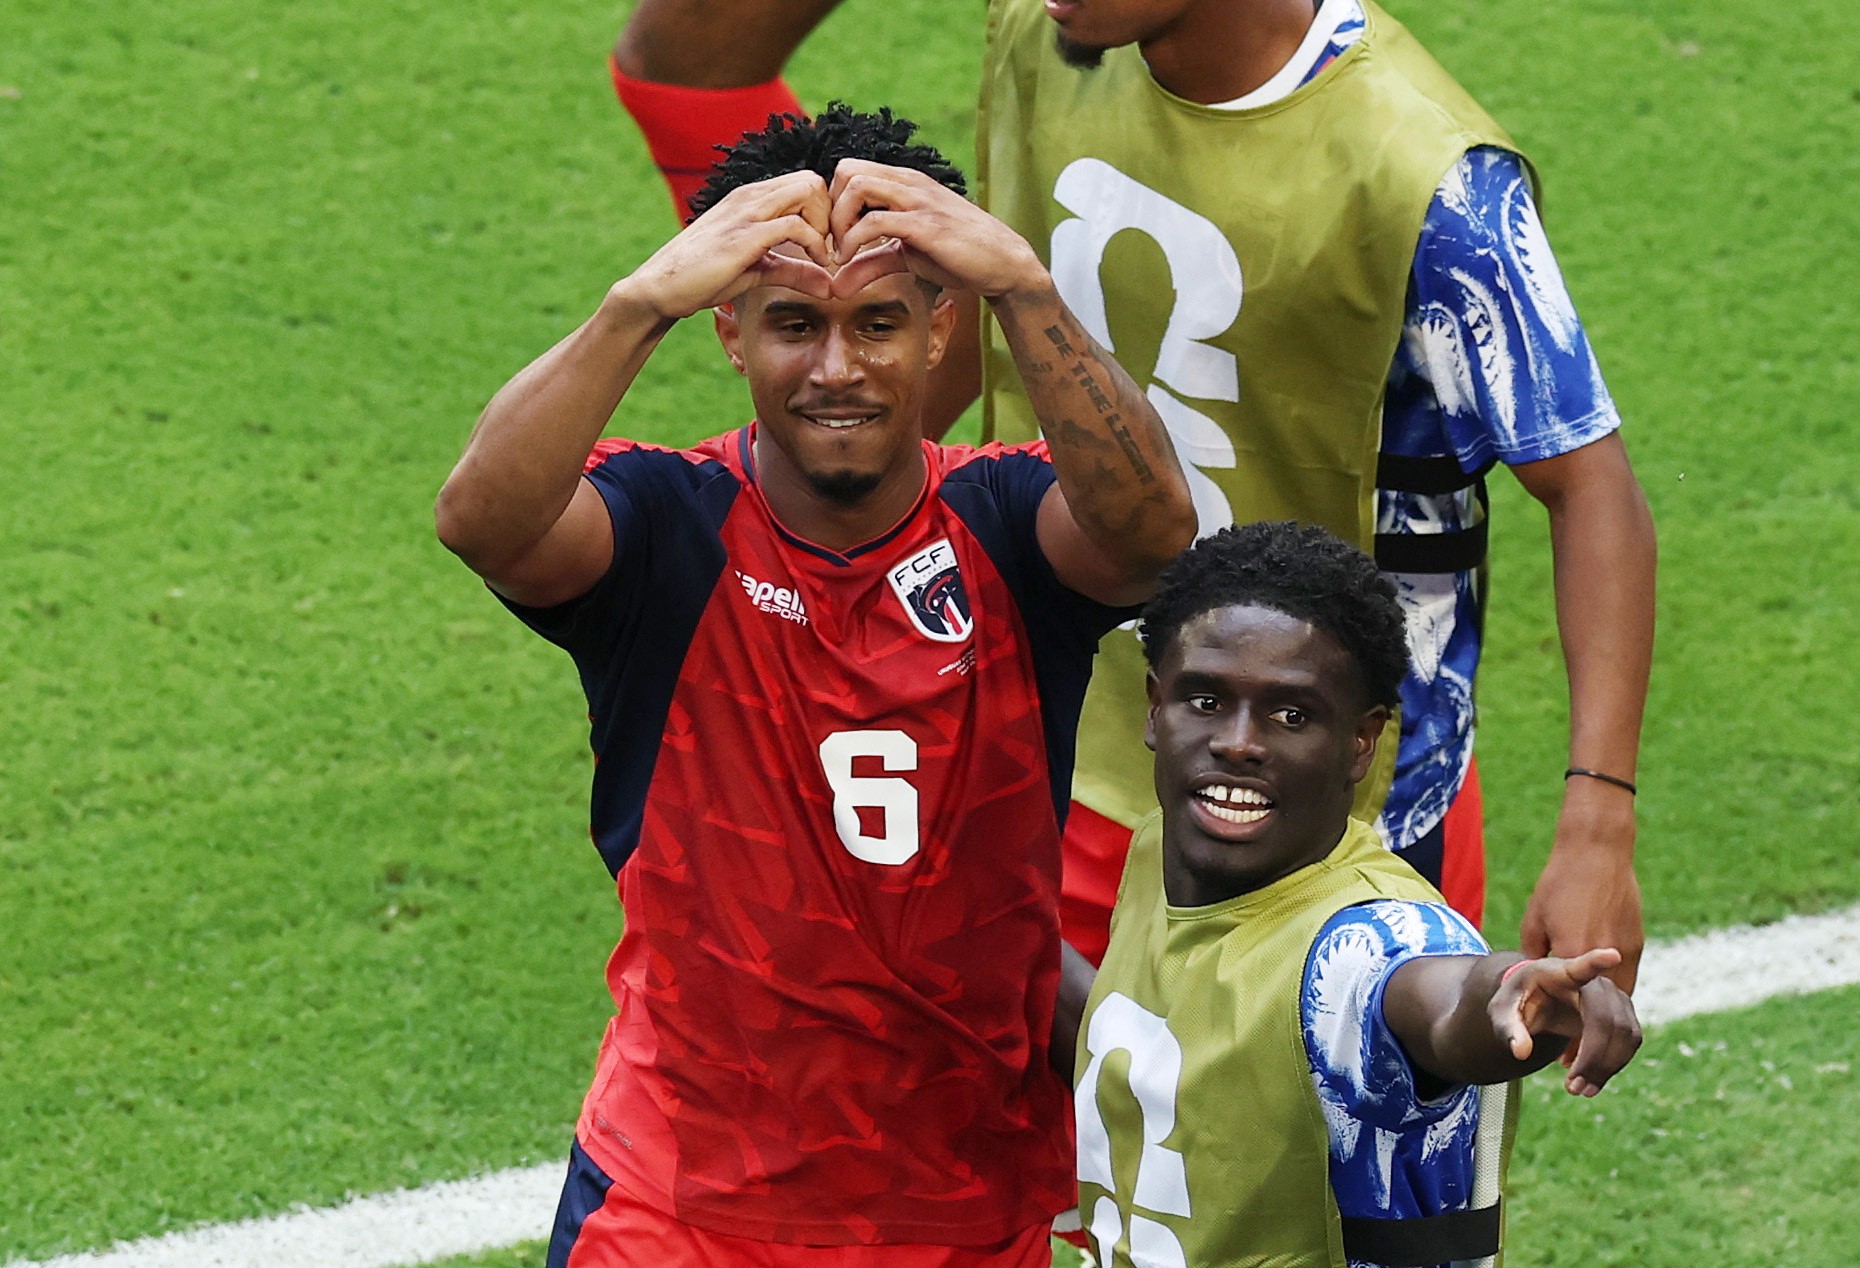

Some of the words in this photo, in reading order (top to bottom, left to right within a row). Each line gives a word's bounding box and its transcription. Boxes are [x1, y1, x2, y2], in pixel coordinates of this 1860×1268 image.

[894, 546, 946, 586] FCF
[759, 601, 810, 626] SPORT
[819, 730, 920, 866] 6
